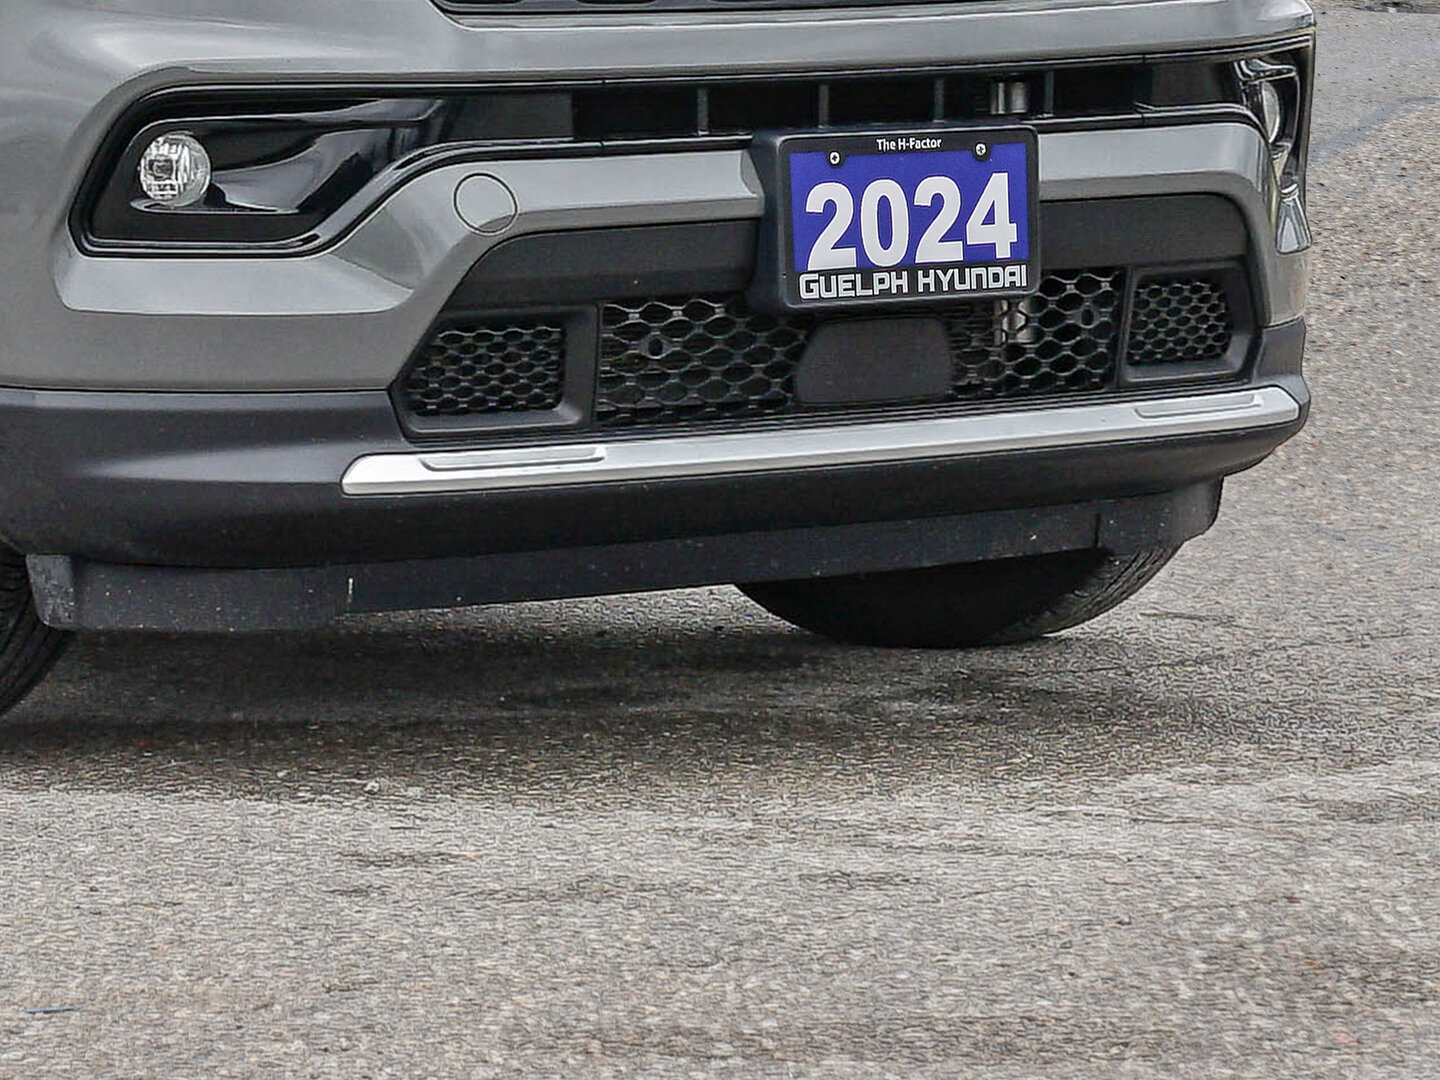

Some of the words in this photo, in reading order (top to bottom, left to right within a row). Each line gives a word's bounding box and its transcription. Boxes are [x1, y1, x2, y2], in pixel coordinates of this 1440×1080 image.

[876, 138, 896, 151] The
[898, 137, 942, 150] H-Factor
[805, 172, 1018, 271] 2024
[799, 271, 909, 300] GUELPH
[917, 265, 1028, 293] HYUNDAI
